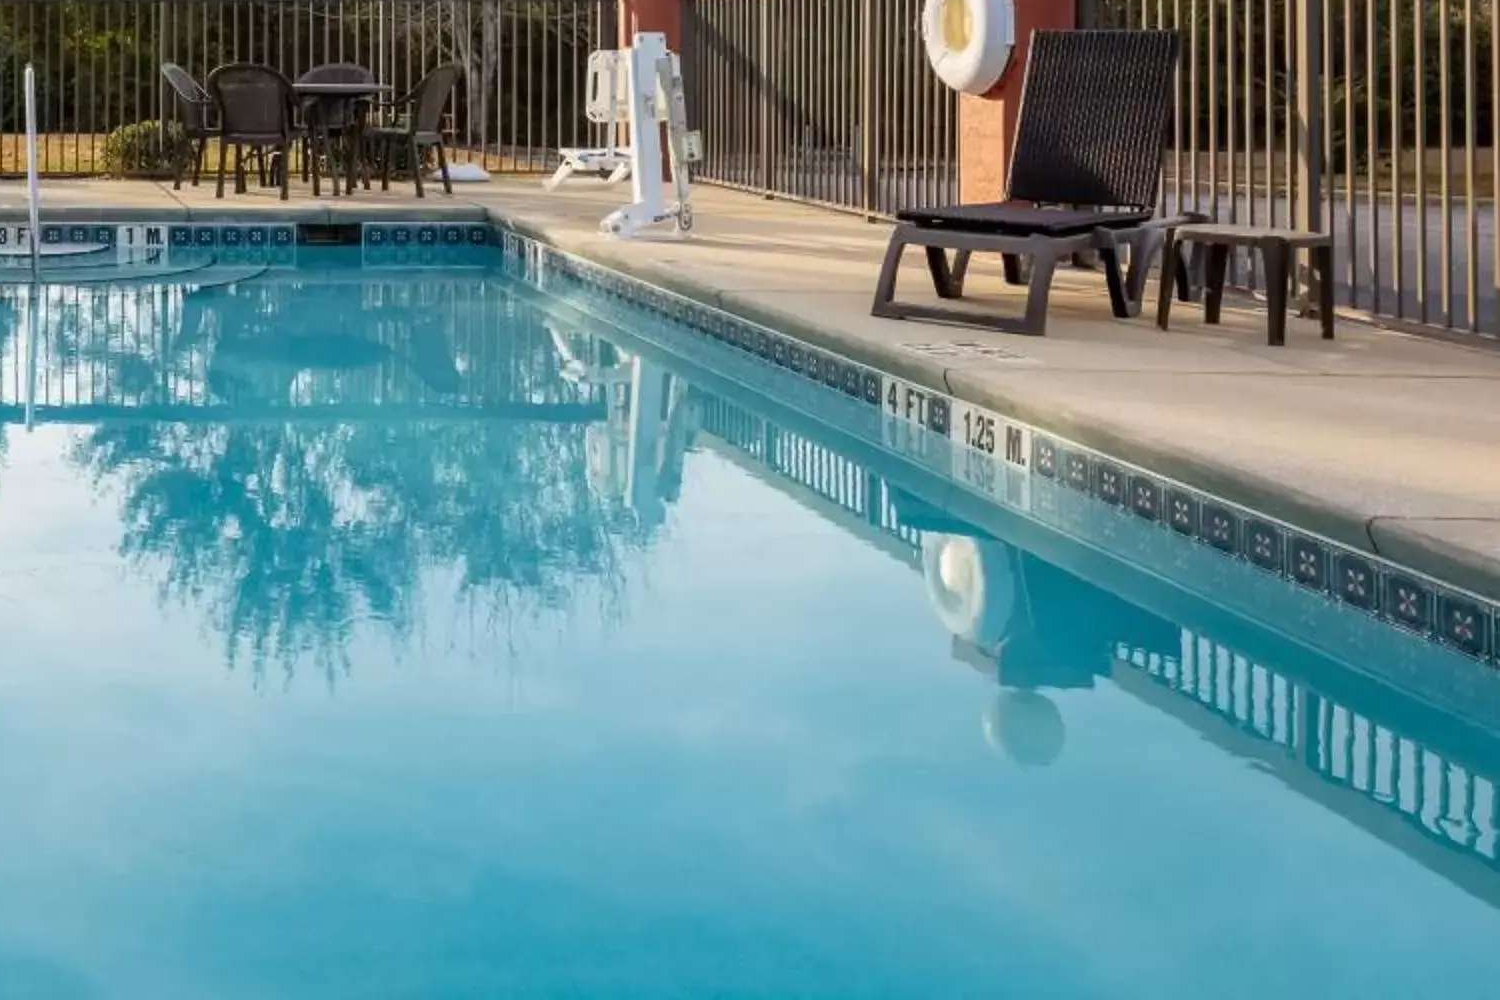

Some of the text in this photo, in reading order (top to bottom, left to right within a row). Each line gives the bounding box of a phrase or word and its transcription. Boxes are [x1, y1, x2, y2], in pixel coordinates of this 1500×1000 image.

[125, 227, 134, 245] 1
[887, 382, 926, 425] 4 FT
[963, 410, 1026, 466] 1.25 M.
